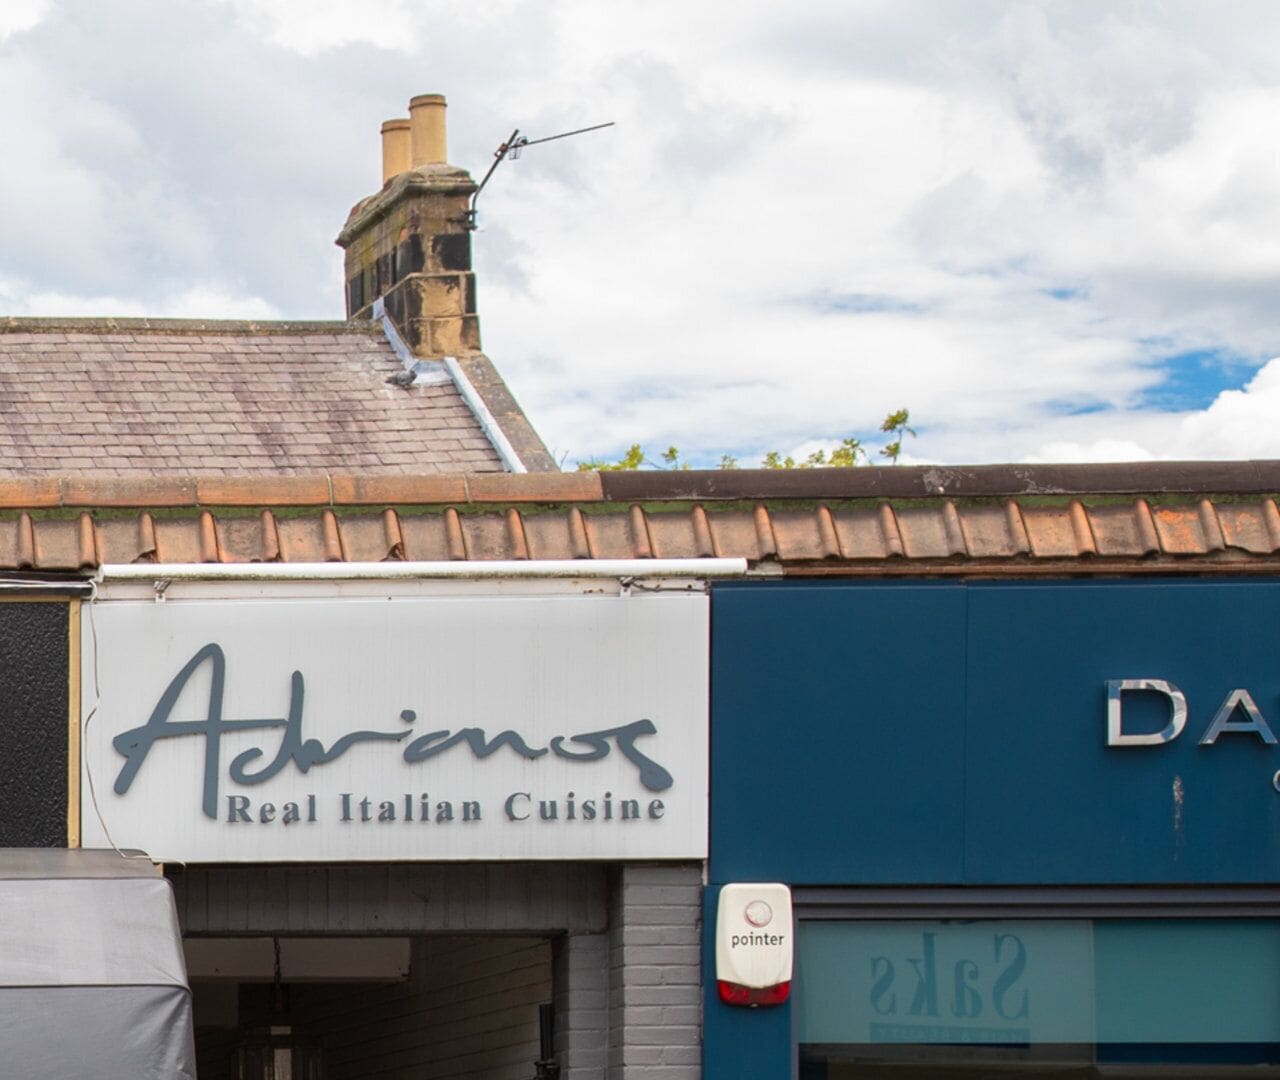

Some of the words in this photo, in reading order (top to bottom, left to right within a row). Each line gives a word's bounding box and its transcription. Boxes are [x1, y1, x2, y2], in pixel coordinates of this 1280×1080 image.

[113, 642, 674, 820] Adrianos
[226, 793, 317, 824] Real
[340, 792, 483, 823] Italian
[504, 790, 666, 823] Cuisine
[731, 931, 785, 949] pointer
